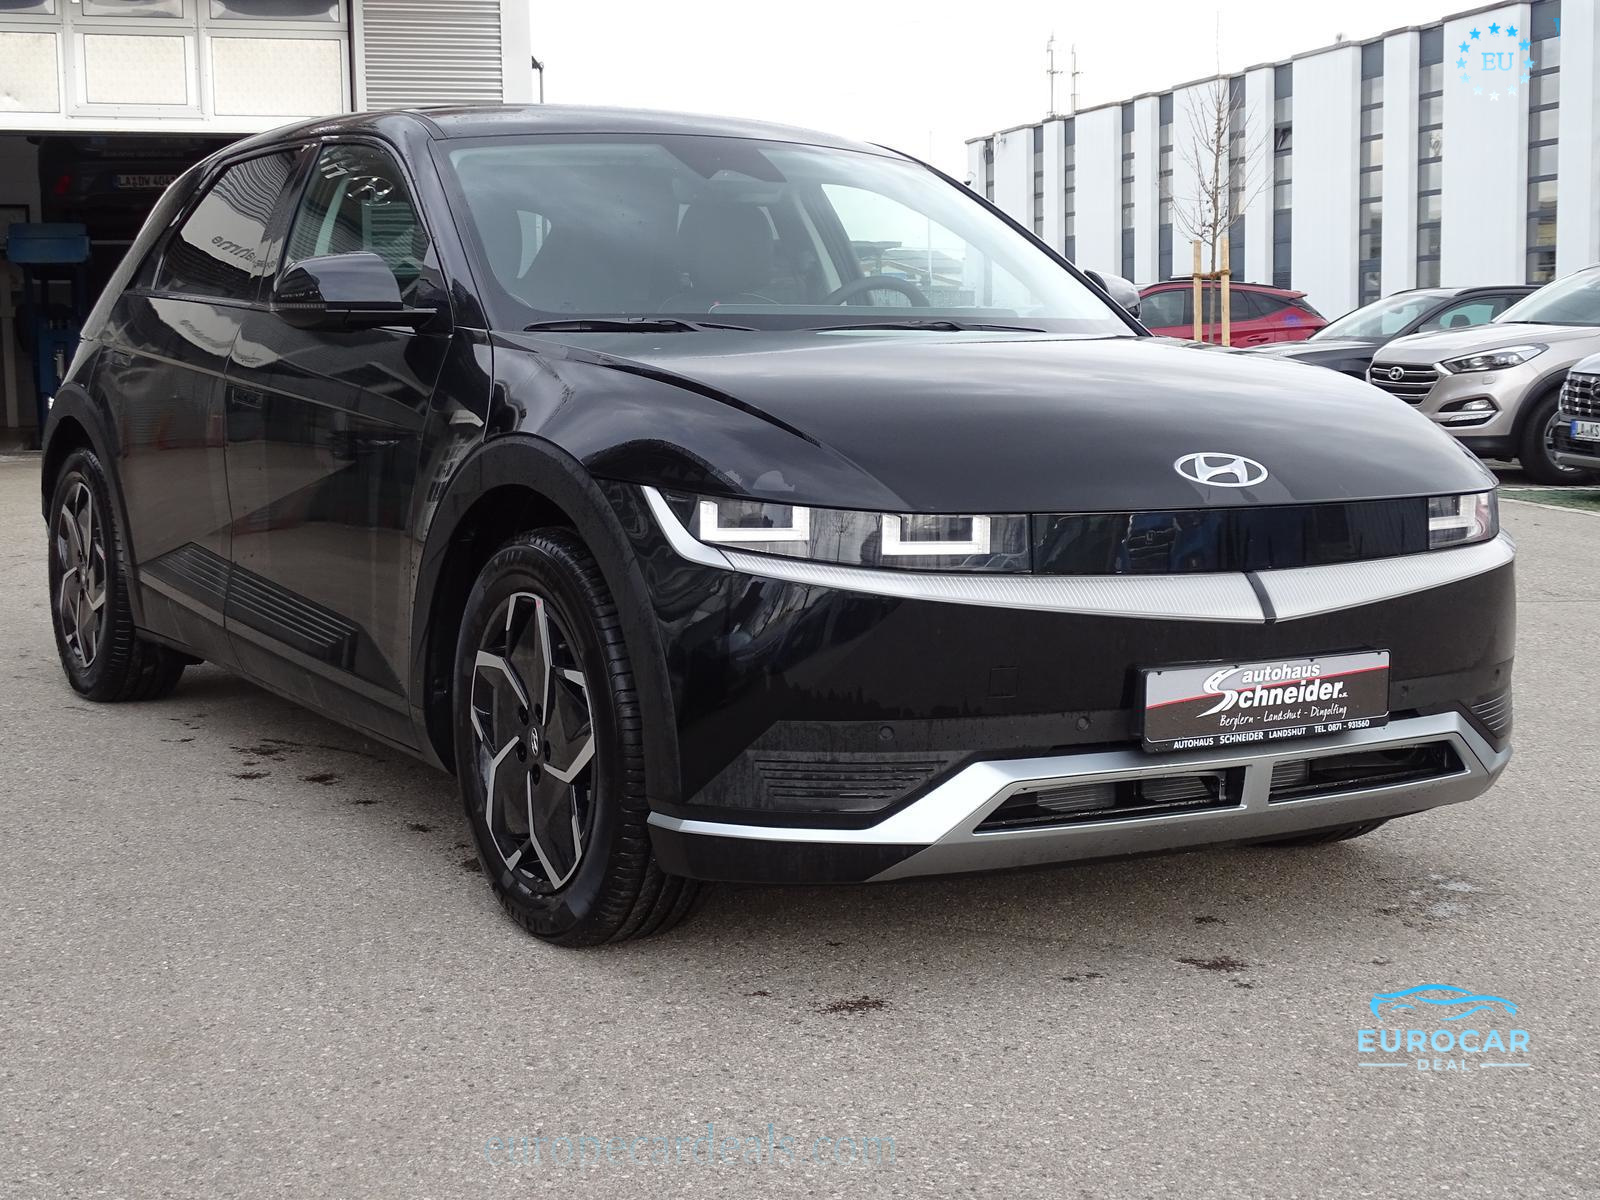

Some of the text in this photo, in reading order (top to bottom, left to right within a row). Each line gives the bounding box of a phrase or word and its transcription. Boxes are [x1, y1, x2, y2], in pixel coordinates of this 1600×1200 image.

[1242, 664, 1320, 683] autohaus
[1219, 712, 1254, 731] Berglern
[1264, 708, 1301, 722] Landshut
[1310, 703, 1347, 721] Dingolfing
[1173, 738, 1214, 749] AUTOHAUS
[1219, 731, 1264, 744] SCHNEIDER
[1268, 727, 1307, 739] LANDSHUT
[1327, 722, 1342, 732] 0871
[1348, 719, 1370, 729] 931560
